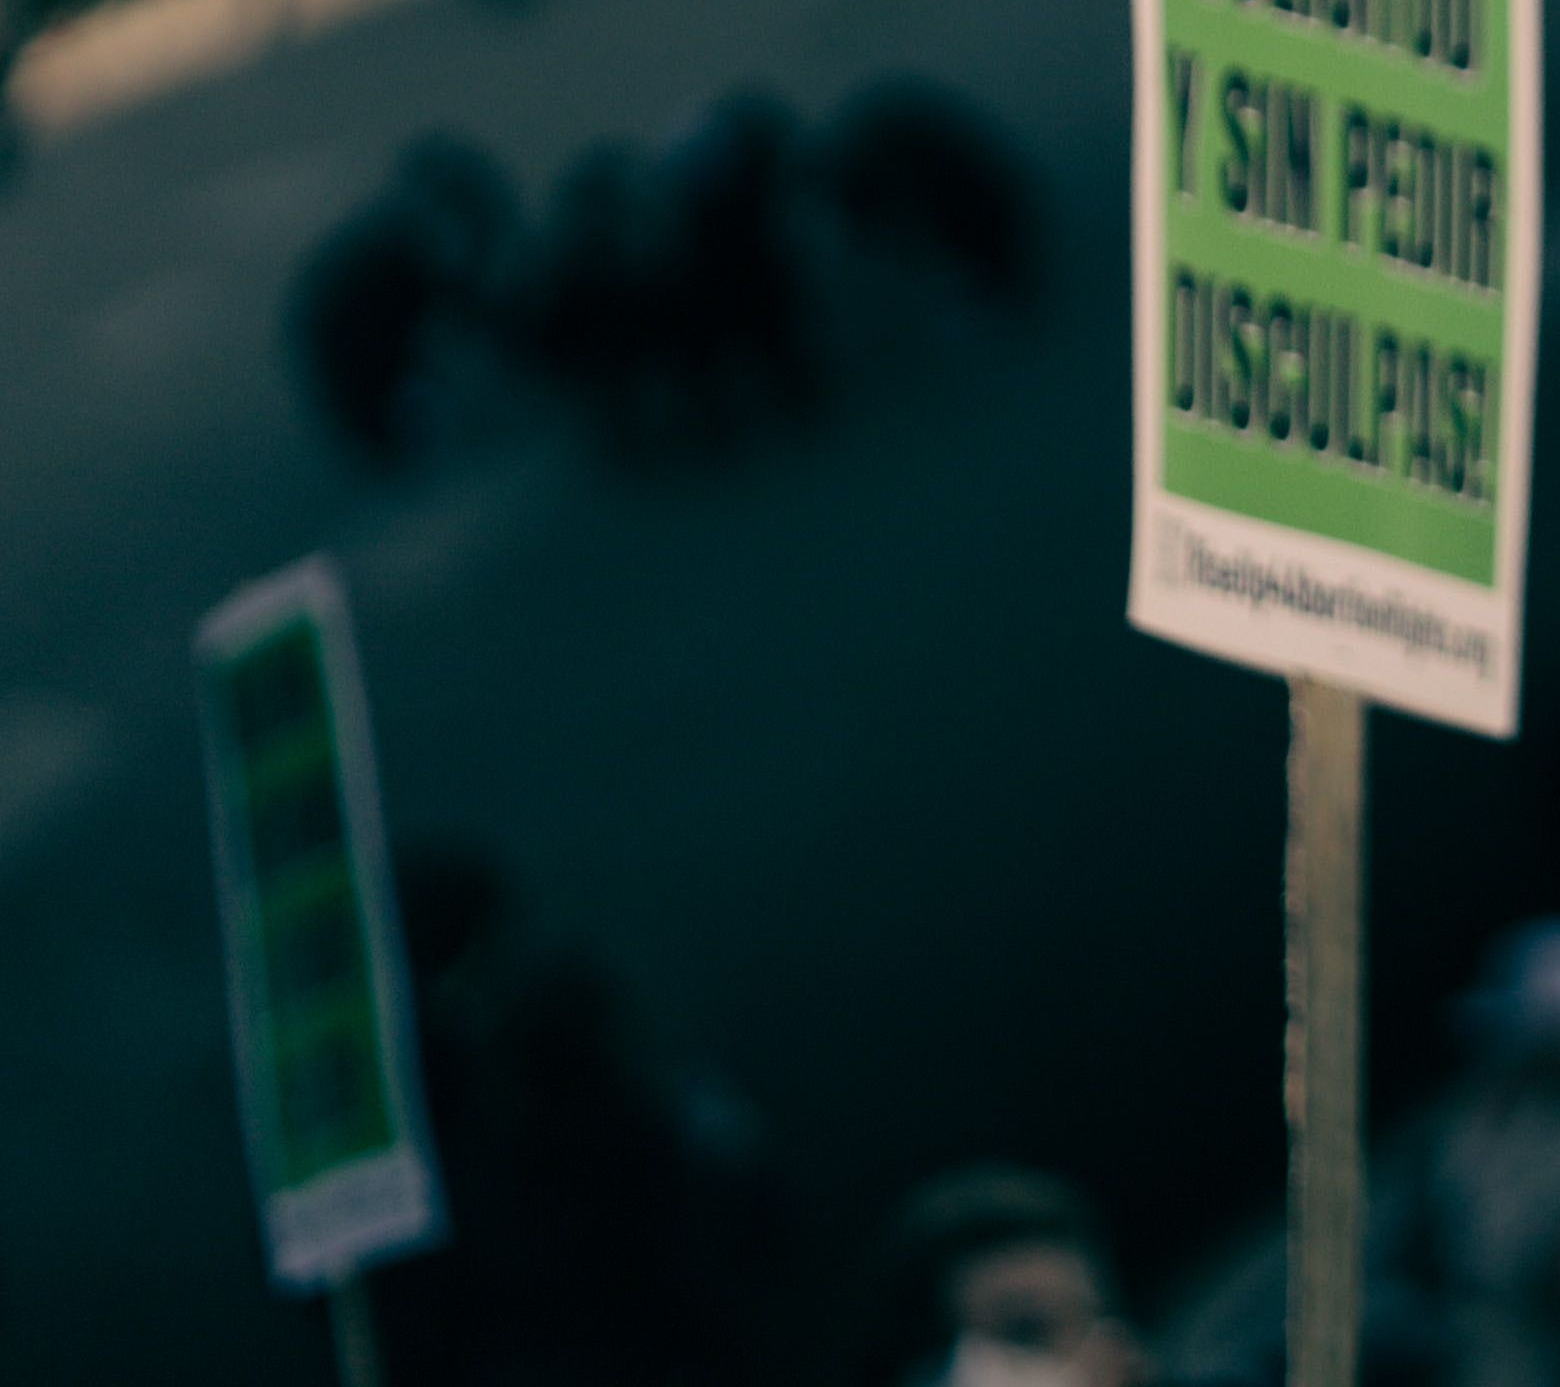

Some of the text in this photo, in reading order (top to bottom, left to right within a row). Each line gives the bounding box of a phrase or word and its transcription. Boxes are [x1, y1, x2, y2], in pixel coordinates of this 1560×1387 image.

[1167, 41, 1502, 295] Y SIN PEDIR
[1169, 261, 1494, 503] DISCULPAS!
